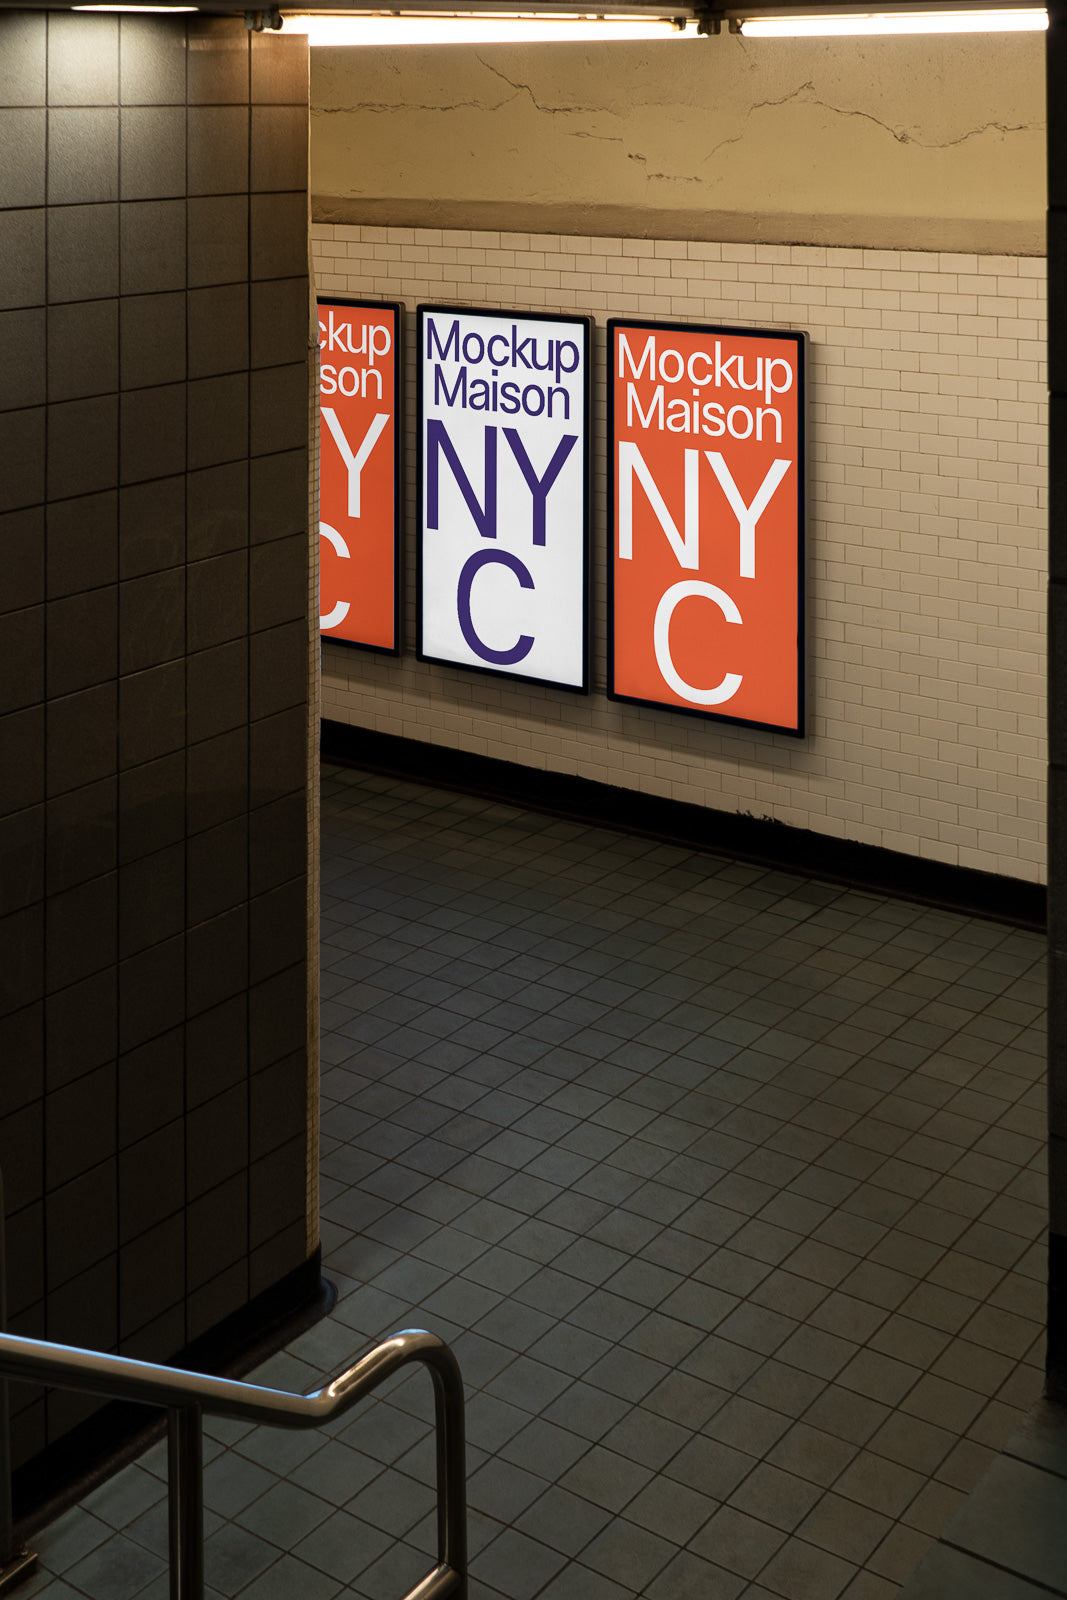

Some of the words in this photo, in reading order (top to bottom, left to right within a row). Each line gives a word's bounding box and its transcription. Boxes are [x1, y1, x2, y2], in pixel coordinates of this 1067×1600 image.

[427, 318, 580, 384] Mockup
[435, 363, 570, 420] Maison
[618, 333, 793, 405] Mockup
[626, 381, 783, 444] Maison
[426, 418, 580, 547] NY
[618, 441, 793, 579] NY
[457, 548, 536, 666] C
[653, 580, 744, 706] C
